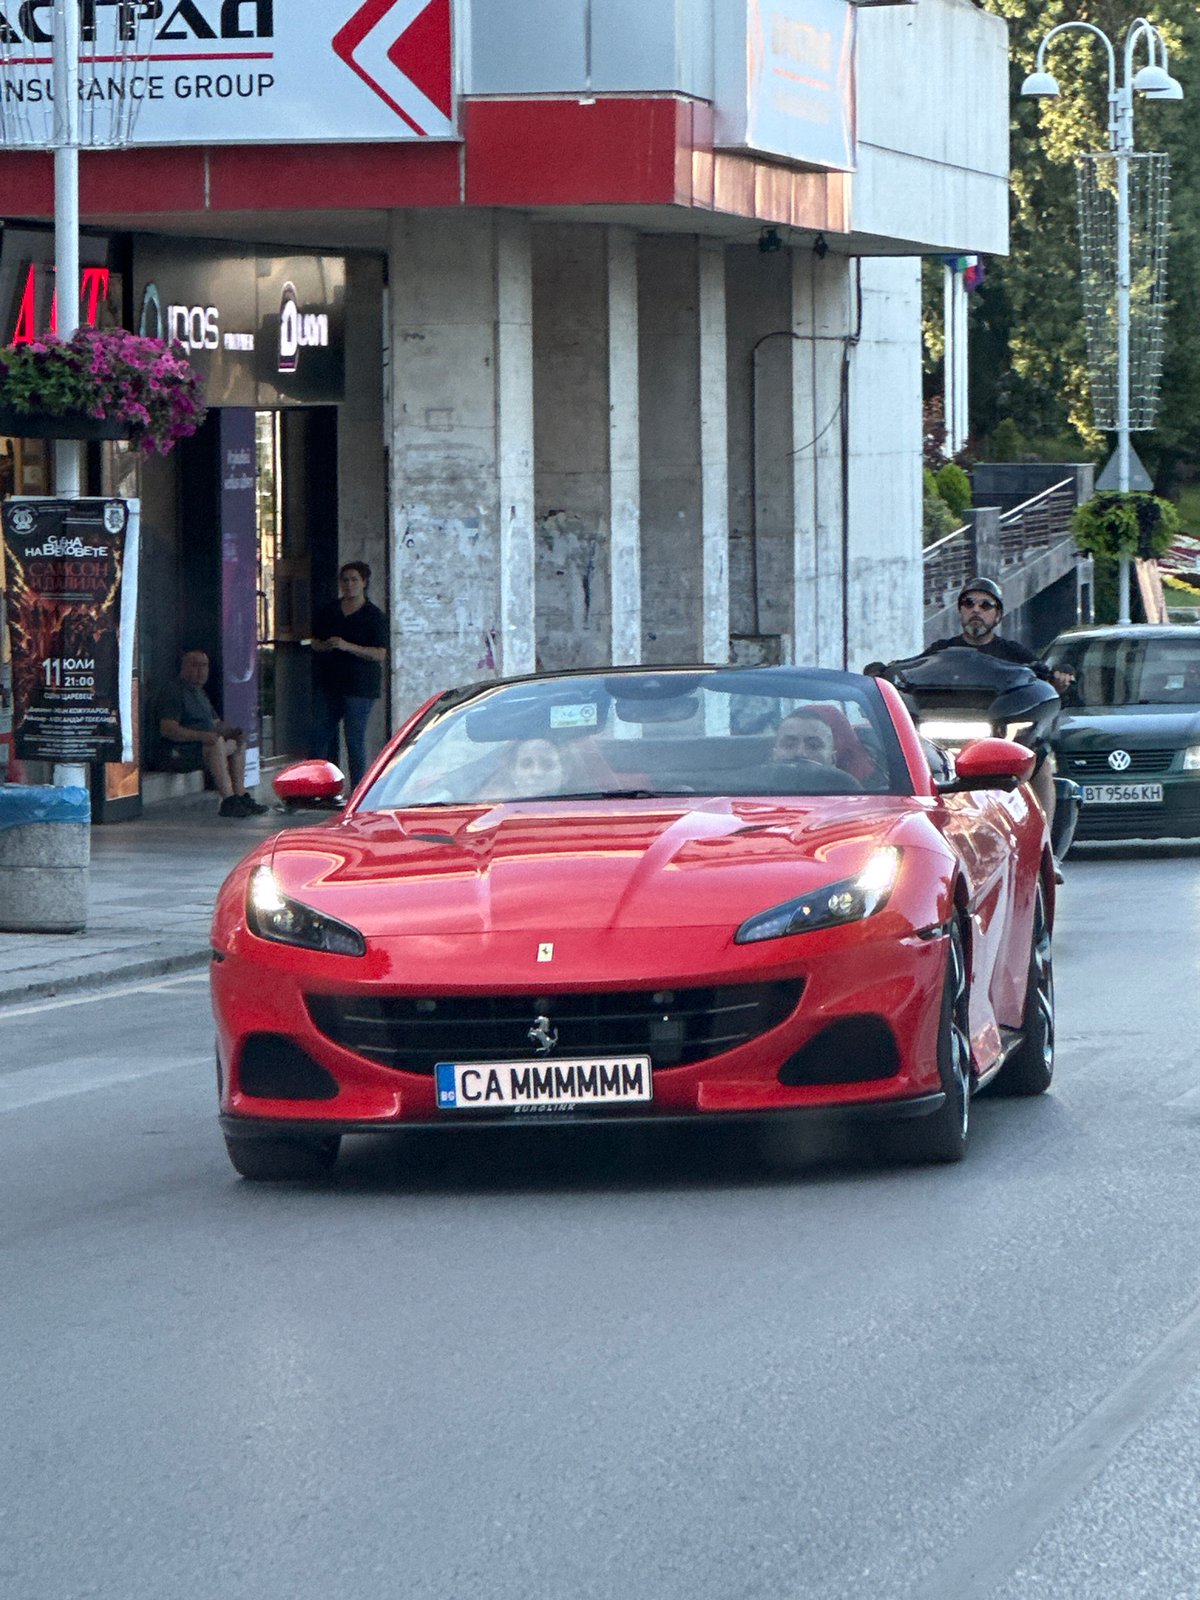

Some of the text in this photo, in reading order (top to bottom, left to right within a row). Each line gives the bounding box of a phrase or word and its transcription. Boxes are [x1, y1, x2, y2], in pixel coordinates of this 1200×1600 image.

[174, 74, 274, 99] GROUP
[42, 658, 95, 686] 11 ЮЛИ
[64, 676, 95, 687] 21:00
[1085, 786, 1160, 801] BT 9566 KH
[441, 1091, 455, 1101] BG
